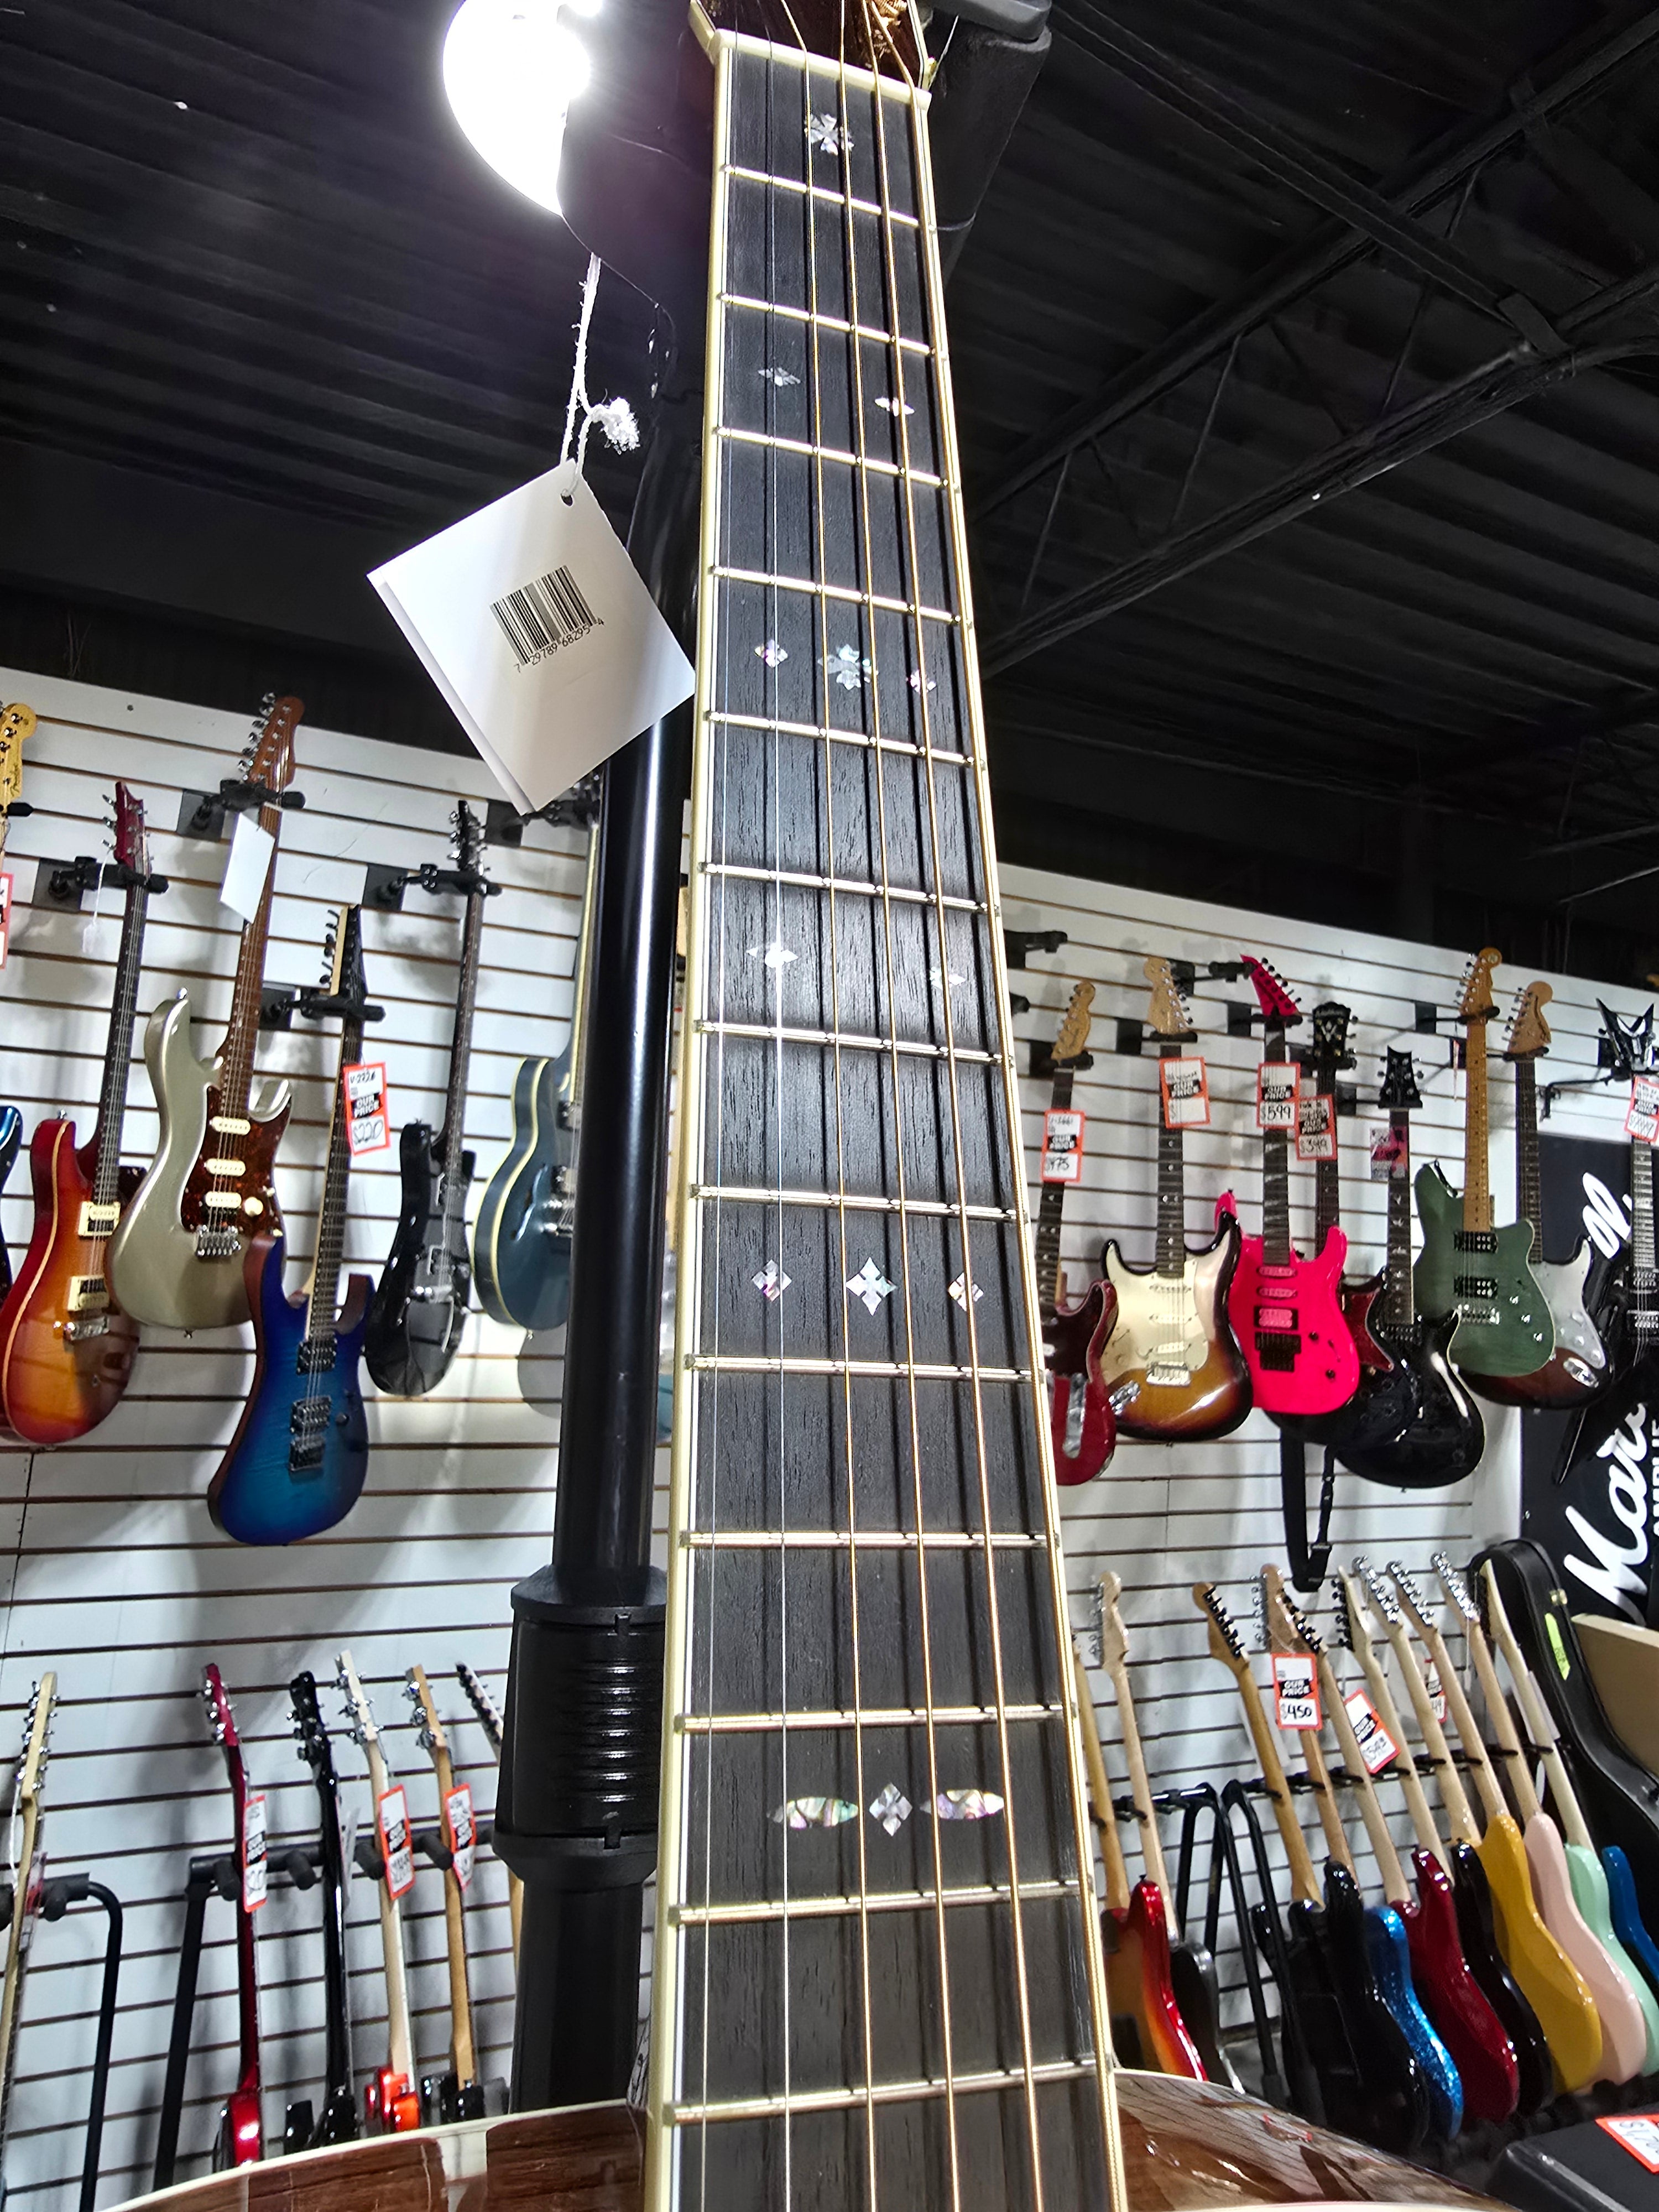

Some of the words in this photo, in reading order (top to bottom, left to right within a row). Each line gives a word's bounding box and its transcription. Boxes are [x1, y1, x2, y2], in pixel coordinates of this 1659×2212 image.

[514, 664, 520, 673] 7
[530, 643, 558, 666] 29789
[562, 624, 591, 647] 68295
[597, 617, 604, 625] 4
[356, 1094, 375, 1108] OUR
[354, 1100, 379, 1118] PRICE
[1282, 1685, 1310, 1697] PRICE
[1284, 1680, 1305, 1689] OUR
[1281, 1704, 1312, 1719] $450
